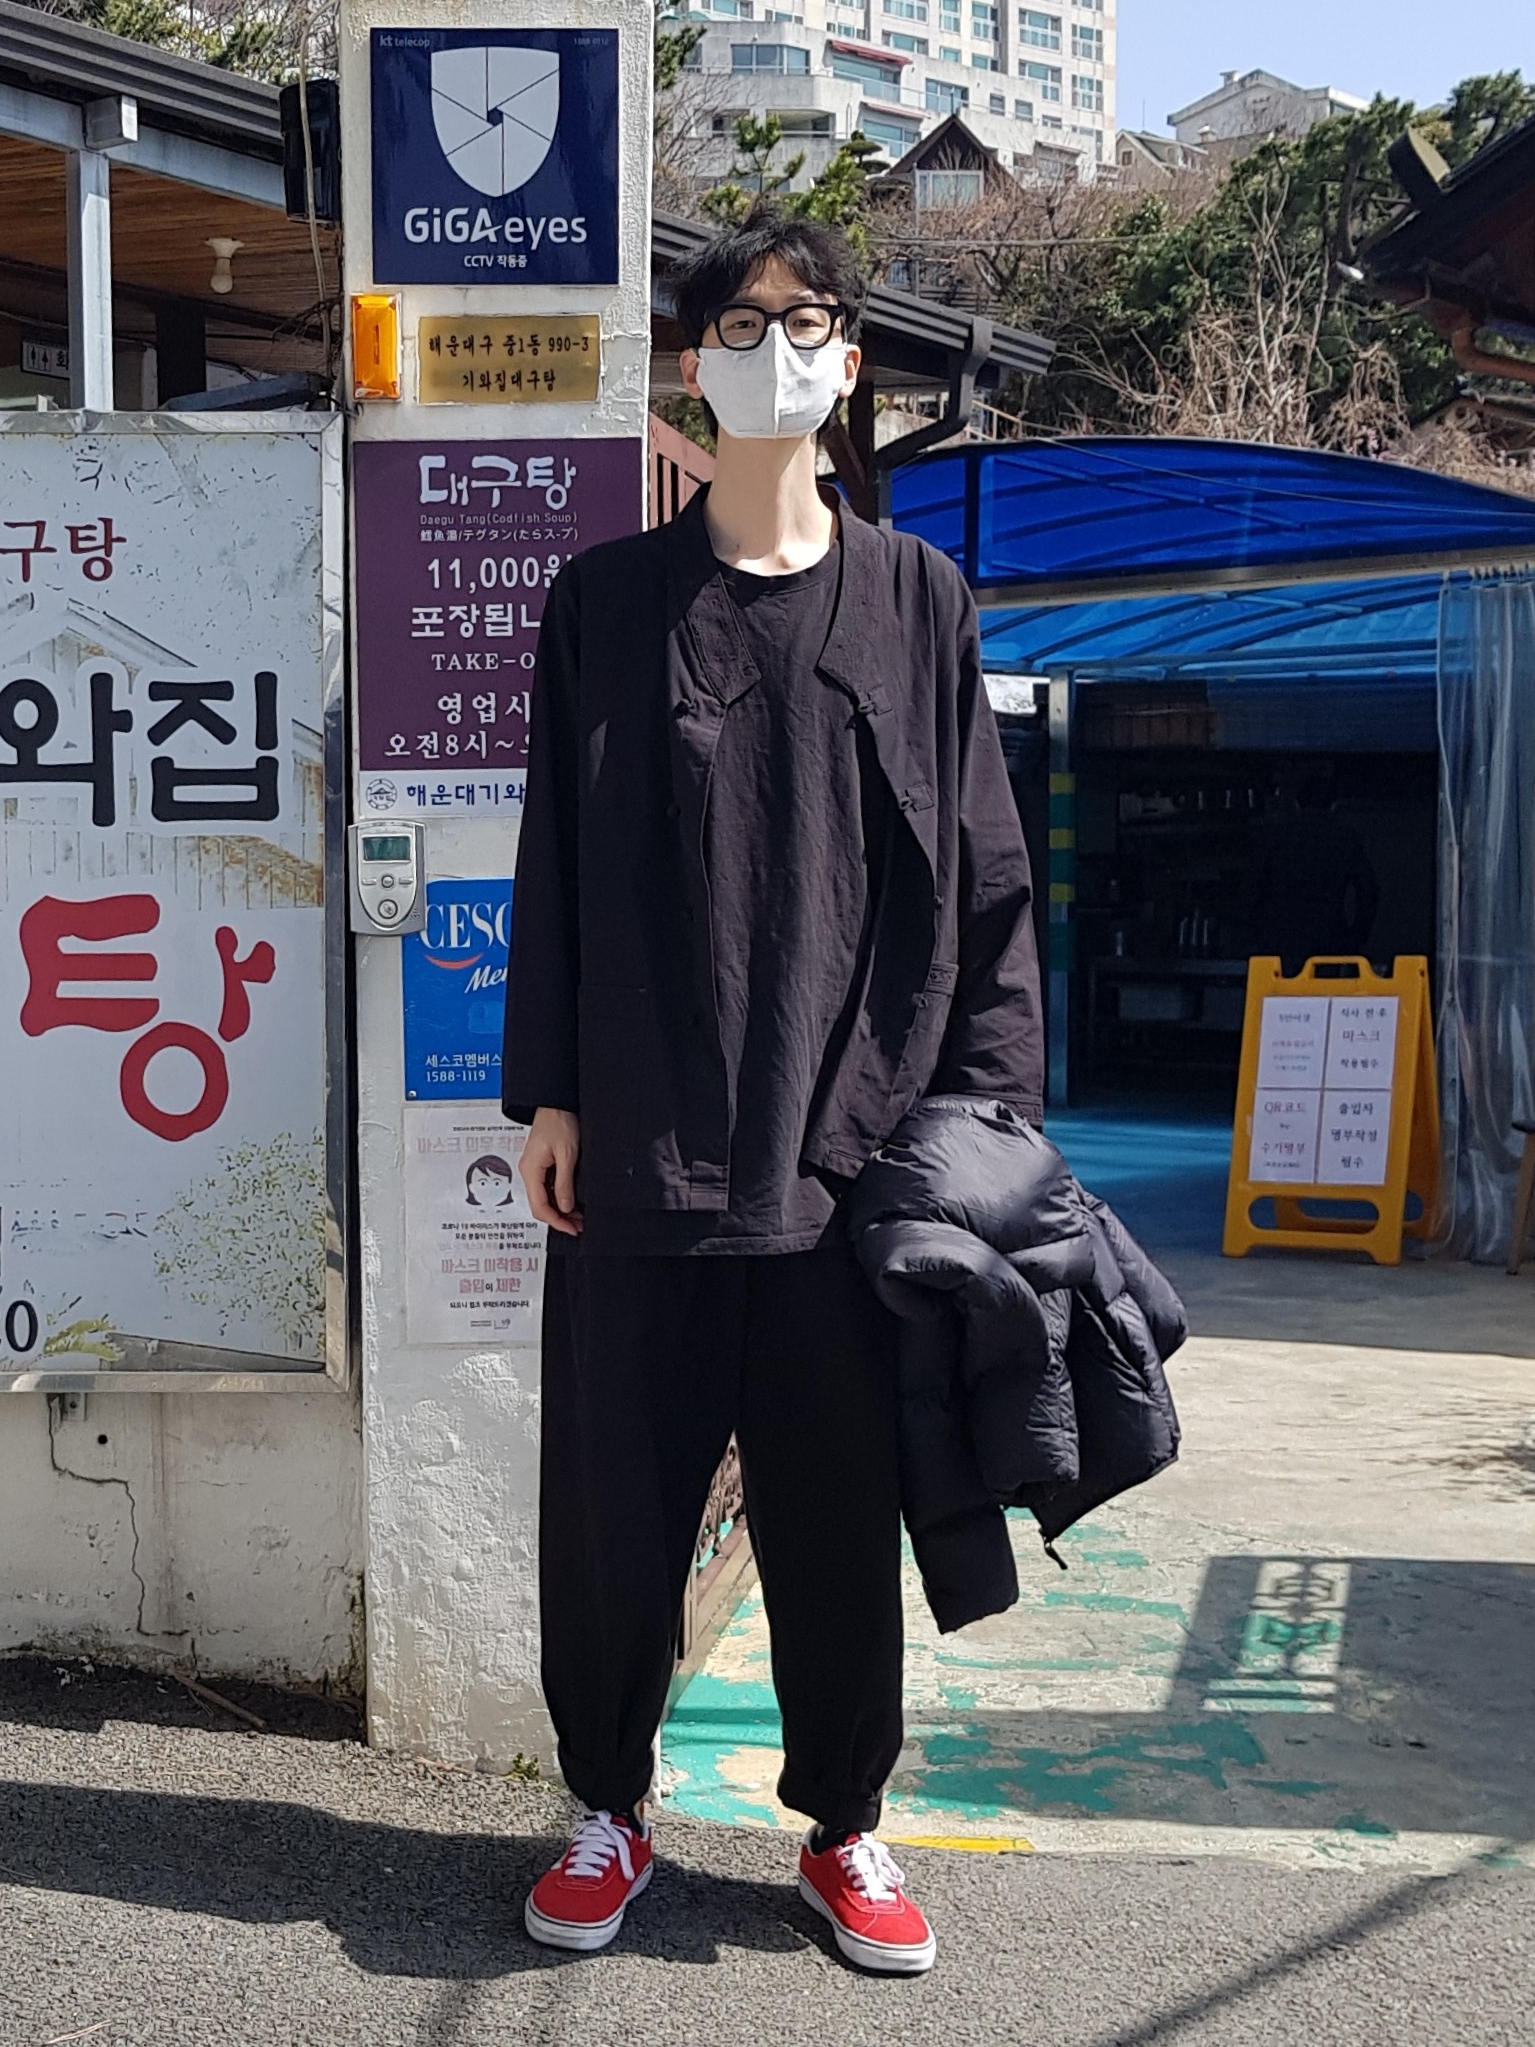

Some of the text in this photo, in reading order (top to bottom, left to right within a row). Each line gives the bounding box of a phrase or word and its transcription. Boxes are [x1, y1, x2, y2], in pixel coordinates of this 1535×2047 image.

[380, 35, 431, 48] kt telecop
[464, 255, 527, 267] CCTV 작동중
[428, 334, 589, 357] 해운대구 중1동 990-3
[462, 368, 556, 392] 기와집대구탕
[419, 455, 577, 510] 대구탕
[420, 514, 454, 526] Daegu
[544, 512, 578, 524] Soup)
[0, 517, 127, 582] 구탕
[0, 672, 280, 827] 와집
[406, 783, 526, 807] 해운대기와
[20, 893, 276, 1142] 탕
[1342, 1029, 1380, 1042] 마스크
[425, 1053, 502, 1068] 세스코멤버스
[426, 1070, 486, 1083] 1588-1119
[1340, 1102, 1373, 1115] 출입자
[1331, 1128, 1378, 1142] 명부작성
[417, 1137, 461, 1154] 마스크
[1341, 1155, 1364, 1168] 필수
[441, 1222, 459, 1230] 코로나
[441, 1257, 538, 1274] 마스크 미착용 시
[460, 1277, 521, 1294] 출입이 제한
